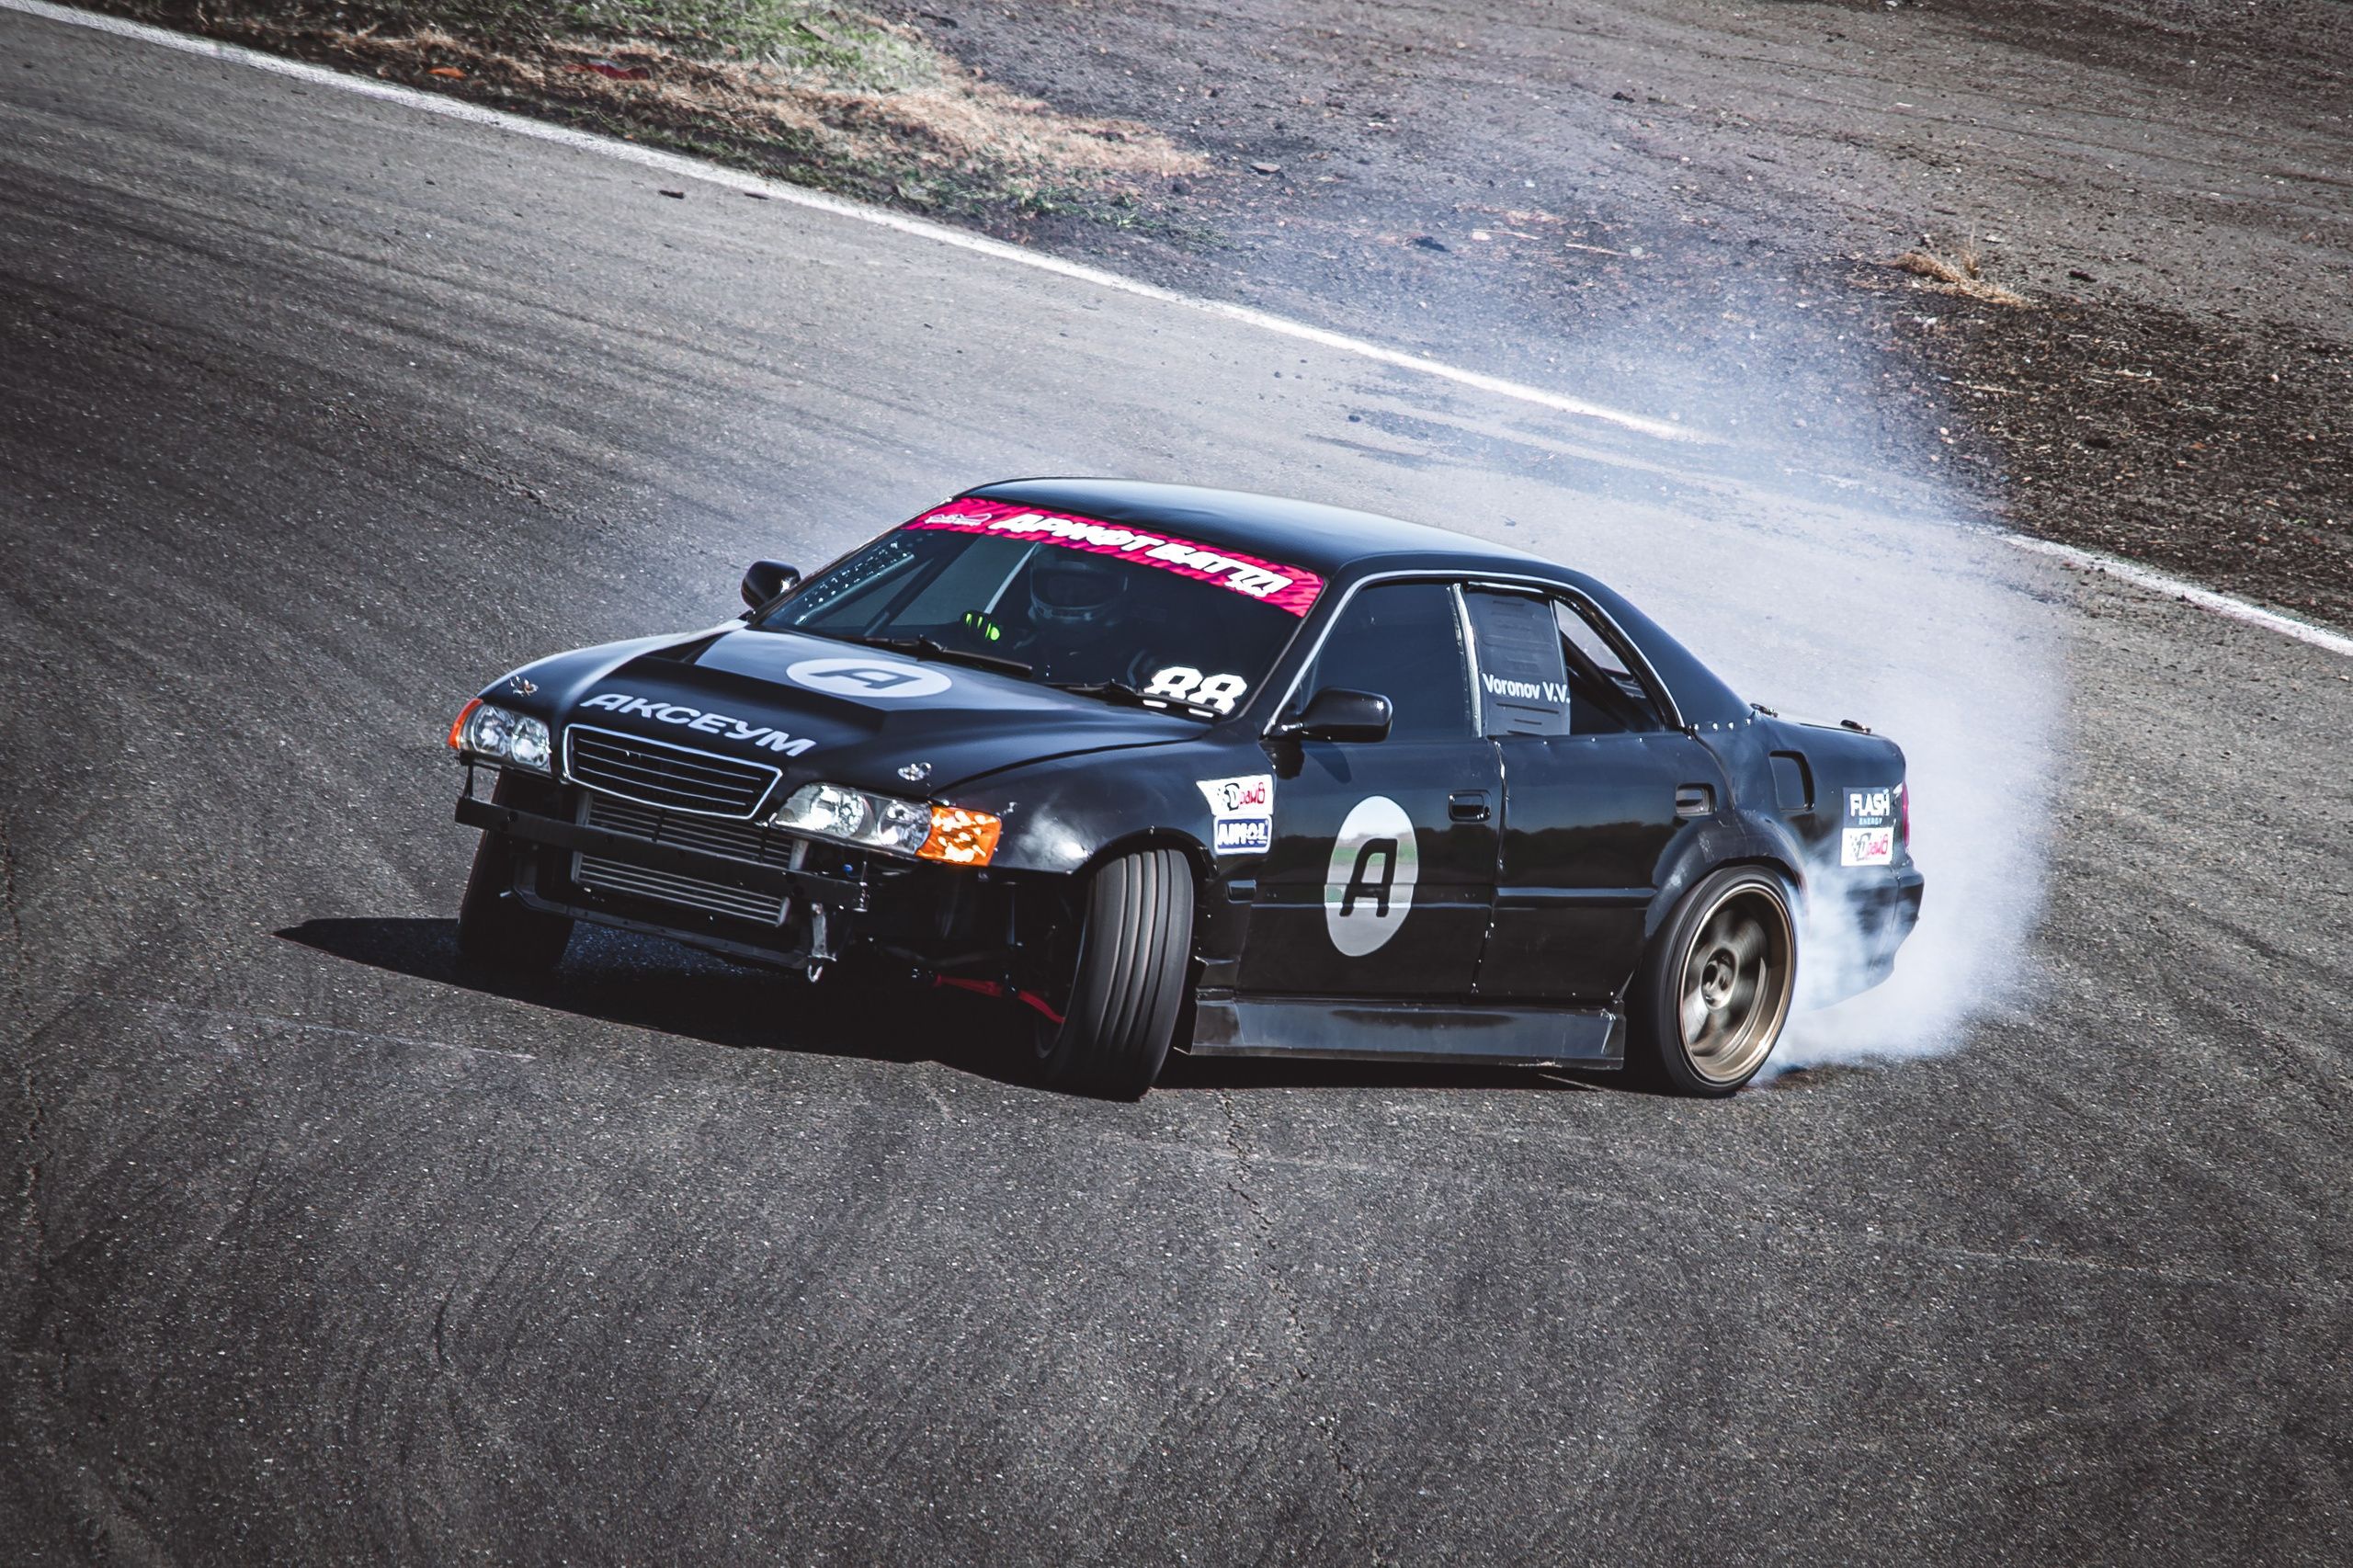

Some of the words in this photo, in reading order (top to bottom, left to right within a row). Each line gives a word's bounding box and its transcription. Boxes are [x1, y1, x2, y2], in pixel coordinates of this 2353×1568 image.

[1142, 666, 1247, 717] 88
[1482, 673, 1540, 699] Voronov
[1542, 681, 1571, 704] V.V.
[1849, 791, 1890, 817] FLASH
